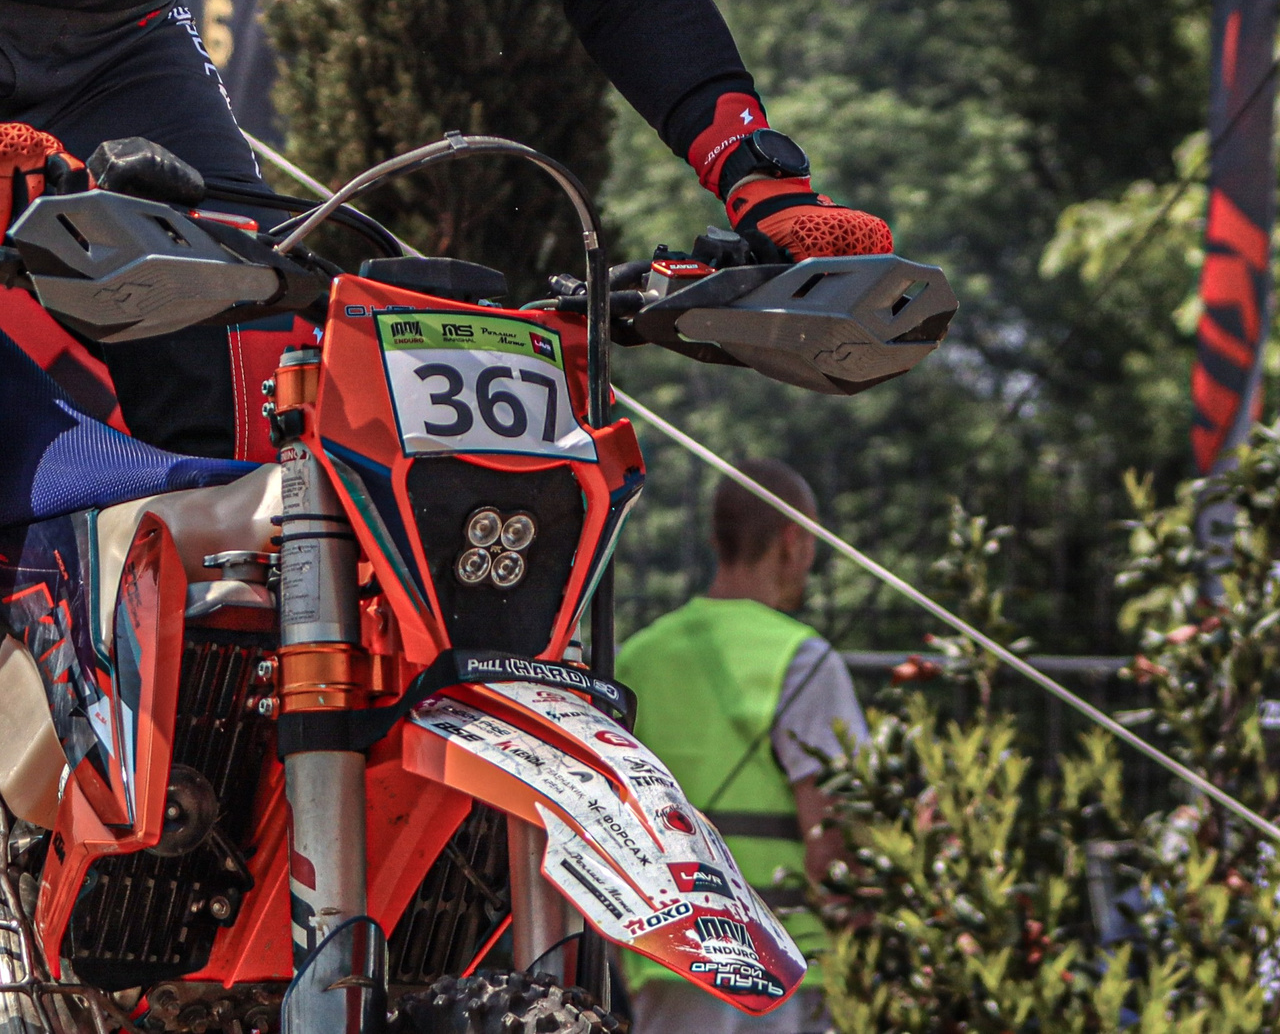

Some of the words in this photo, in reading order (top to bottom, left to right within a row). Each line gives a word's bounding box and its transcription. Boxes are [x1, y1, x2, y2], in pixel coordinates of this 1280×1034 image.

[413, 362, 559, 444] 367
[509, 657, 587, 688] HARD
[510, 746, 546, 768] KENDA
[603, 814, 653, 867] ФОРСАЖ
[680, 871, 723, 886] LAVR
[703, 945, 759, 962] ENDURO
[691, 962, 763, 979] ДРУГОЙ
[716, 973, 784, 997] ПУТЬ
